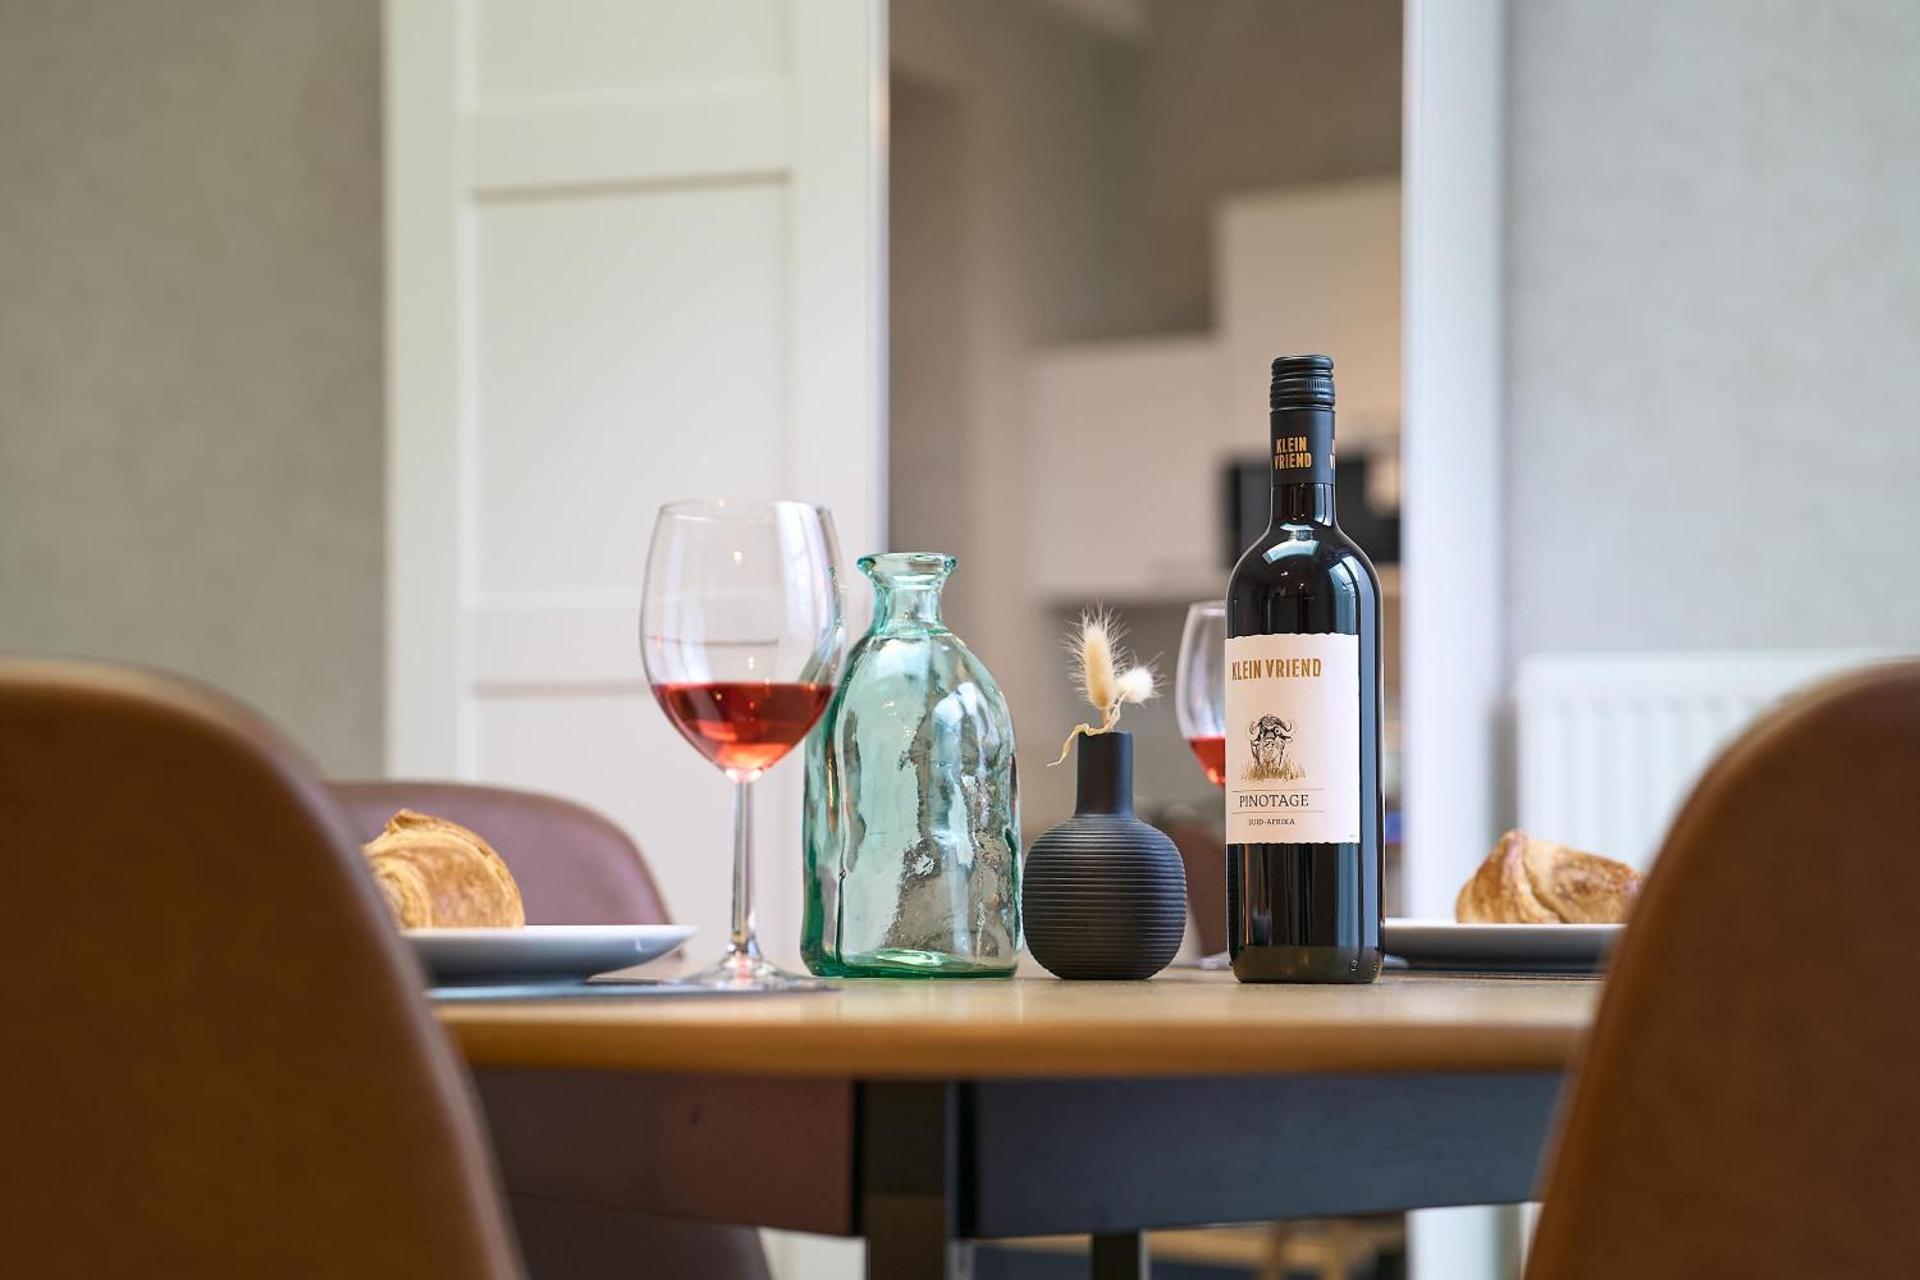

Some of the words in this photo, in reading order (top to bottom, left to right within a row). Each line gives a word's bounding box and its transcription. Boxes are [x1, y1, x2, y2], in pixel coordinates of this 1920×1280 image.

[1276, 436, 1307, 454] KLEIN
[1274, 452, 1312, 470] VRIEND
[1232, 660, 1261, 680] KLEIN
[1265, 658, 1321, 678] VRIEND
[1239, 794, 1309, 807] PINOTAGE
